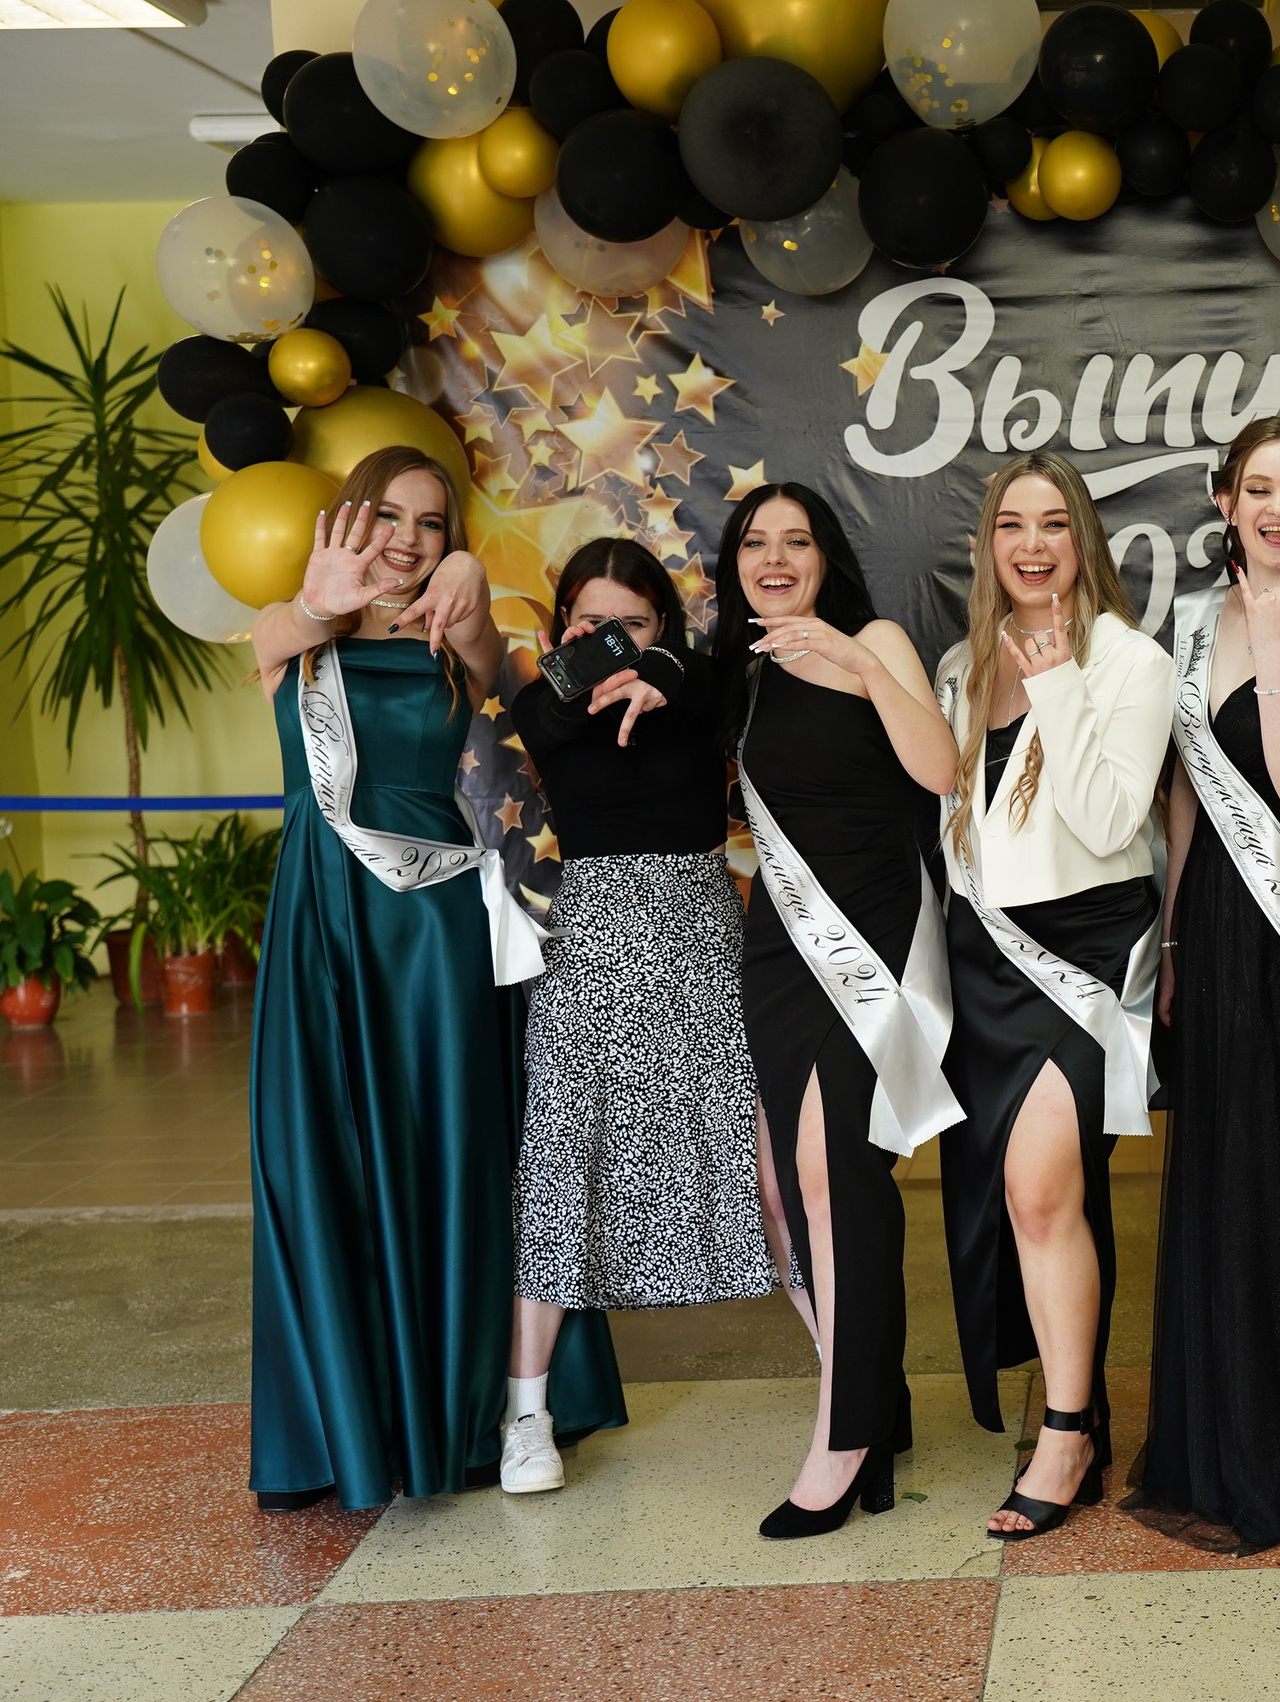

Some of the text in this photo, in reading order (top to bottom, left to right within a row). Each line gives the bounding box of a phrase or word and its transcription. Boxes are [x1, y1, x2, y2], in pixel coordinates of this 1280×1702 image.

[603, 634, 623, 657] 18:11
[1174, 681, 1276, 870] Выпускница
[807, 923, 891, 1007] 2024
